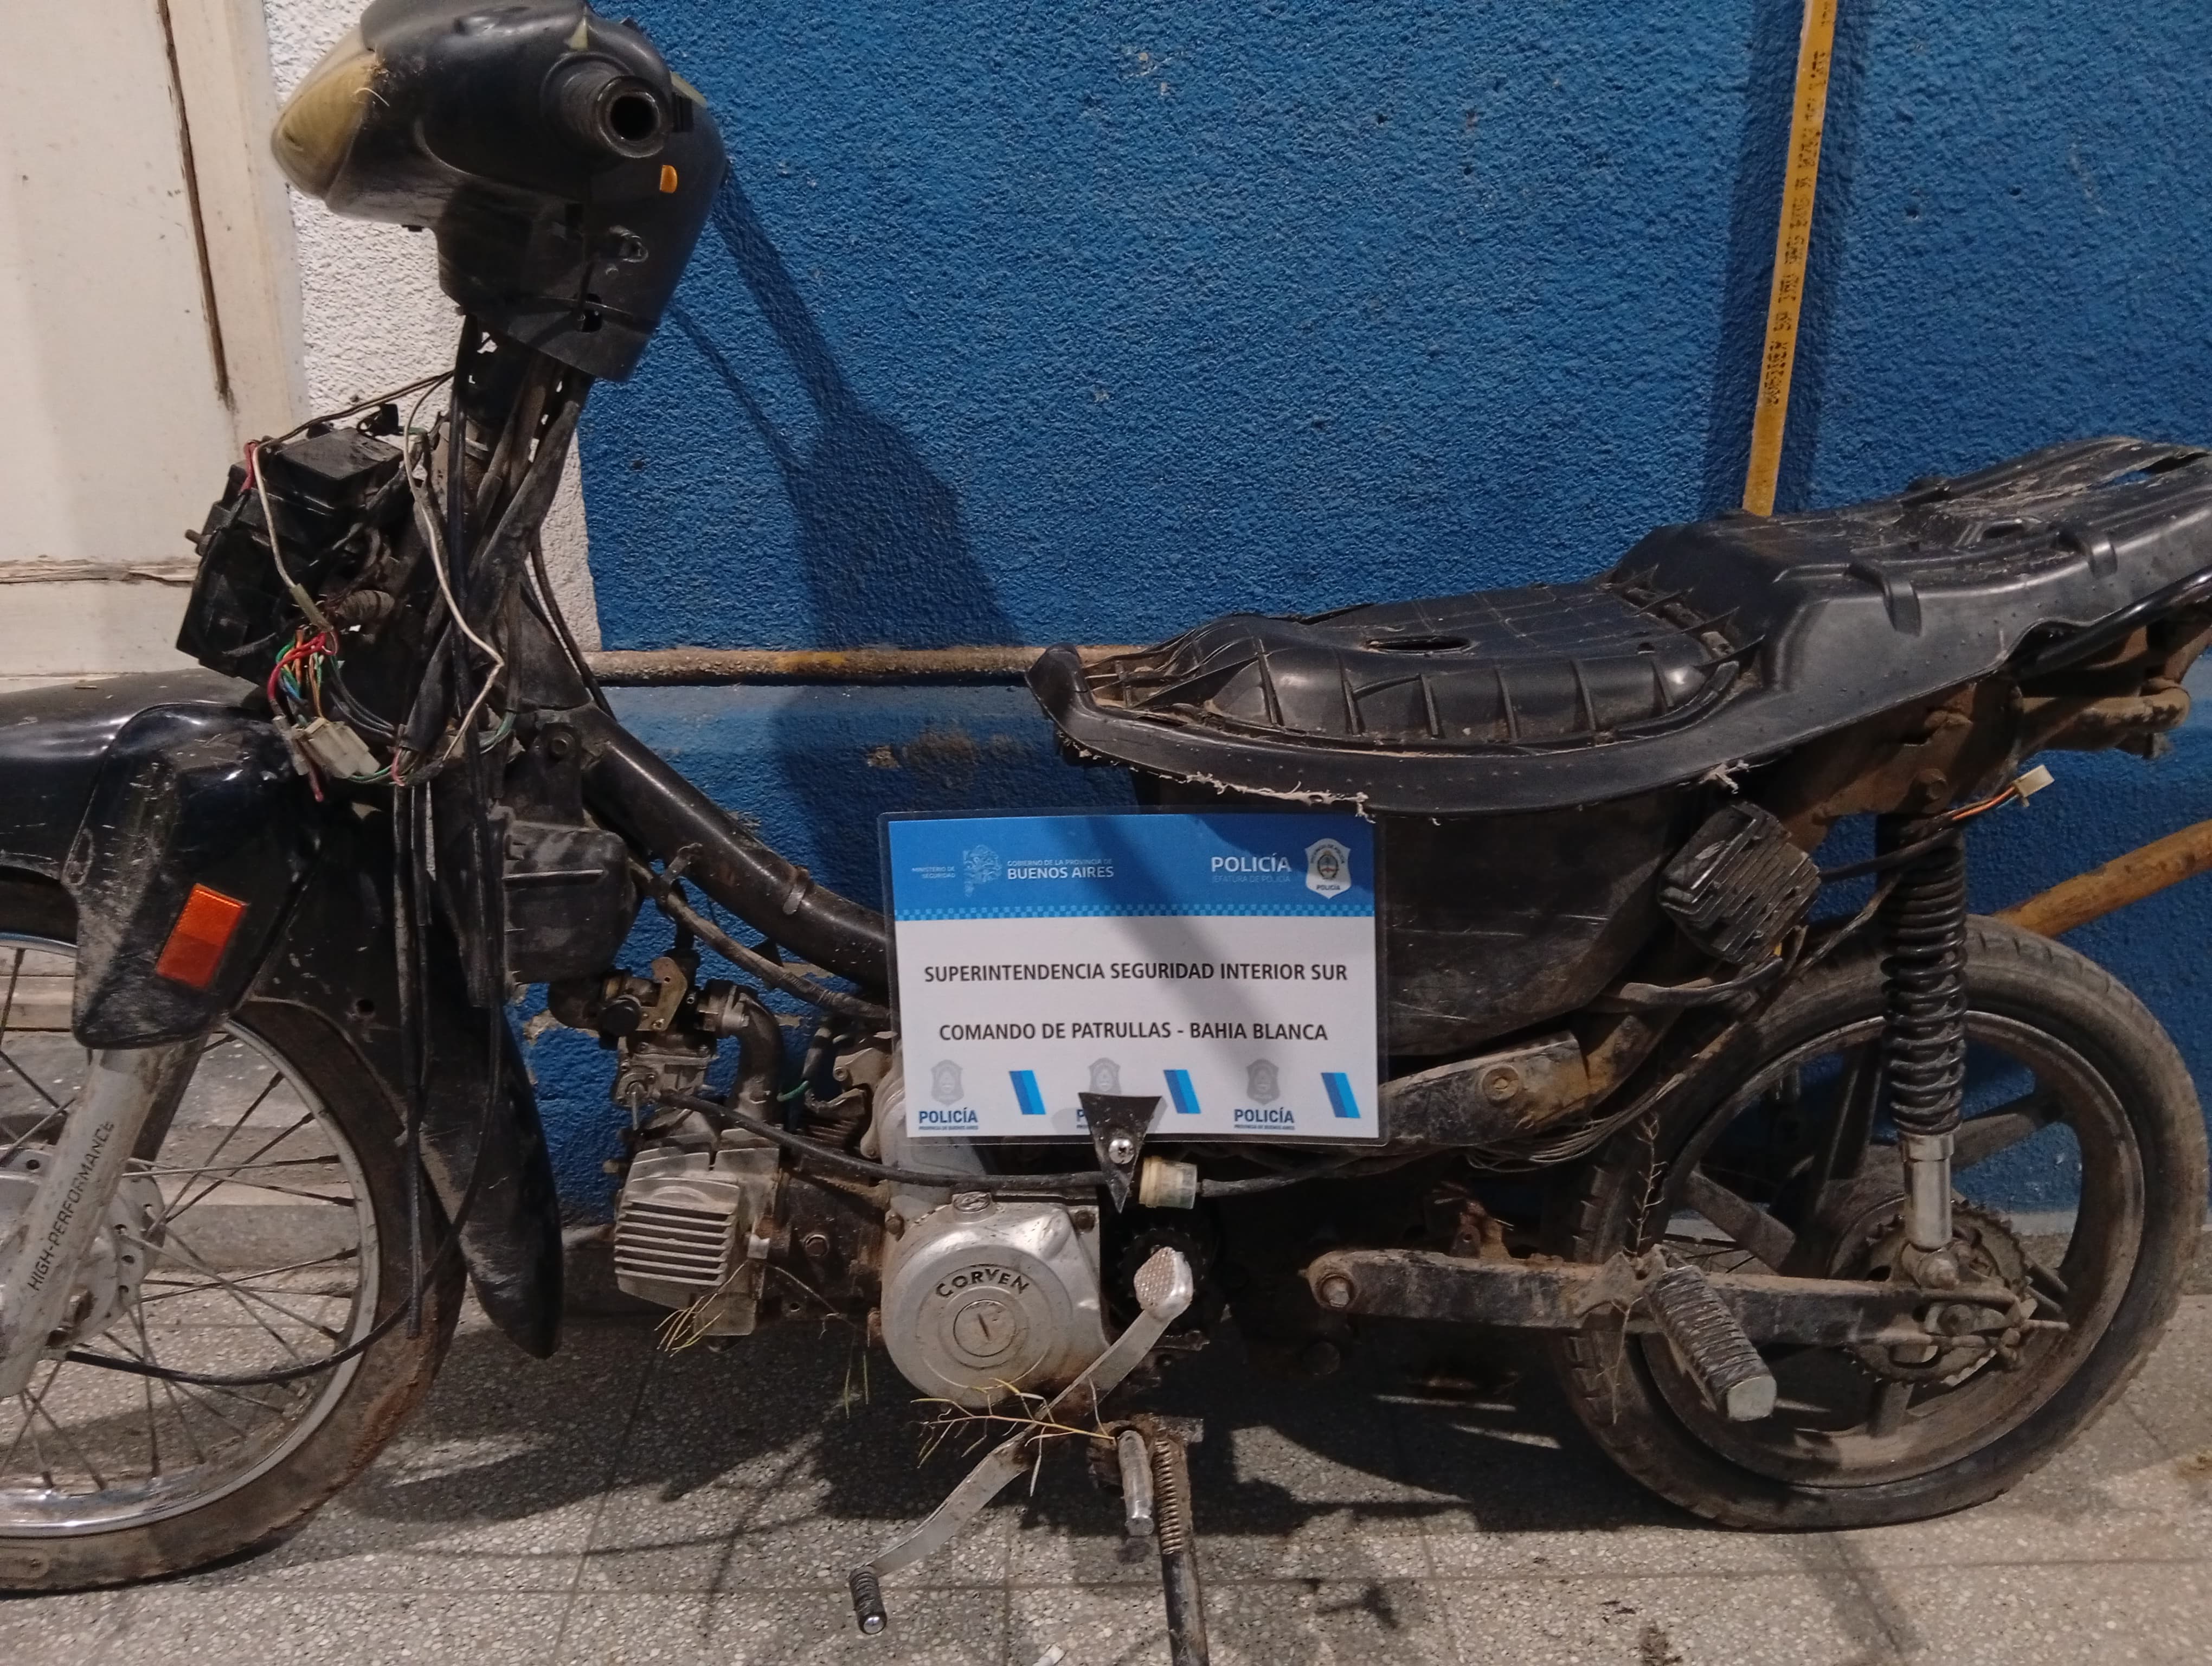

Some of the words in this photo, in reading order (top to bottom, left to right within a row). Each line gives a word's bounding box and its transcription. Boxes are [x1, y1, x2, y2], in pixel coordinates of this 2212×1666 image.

[1211, 853, 1292, 873] POLICÍA
[1007, 867, 1068, 880] BUENOS
[1071, 866, 1114, 878] AIRES
[924, 963, 1105, 982] SUPERINTENDENCIA
[1110, 963, 1214, 979] SEGURIDAD
[1221, 963, 1306, 980] INTERIOR
[1311, 964, 1348, 981] SUR
[939, 1023, 1036, 1041] COMANDO
[1042, 1023, 1066, 1039] DE
[1071, 1022, 1171, 1039] PATRULLAS
[1190, 1022, 1248, 1040] BAHIA
[1253, 1023, 1328, 1041] BLANCA
[918, 1107, 979, 1124] POLICÍA
[1234, 1107, 1295, 1124] POLICÍA
[27, 1121, 115, 1292] HIGH-PERFORMANCE
[935, 1268, 1030, 1298] CORVEN
